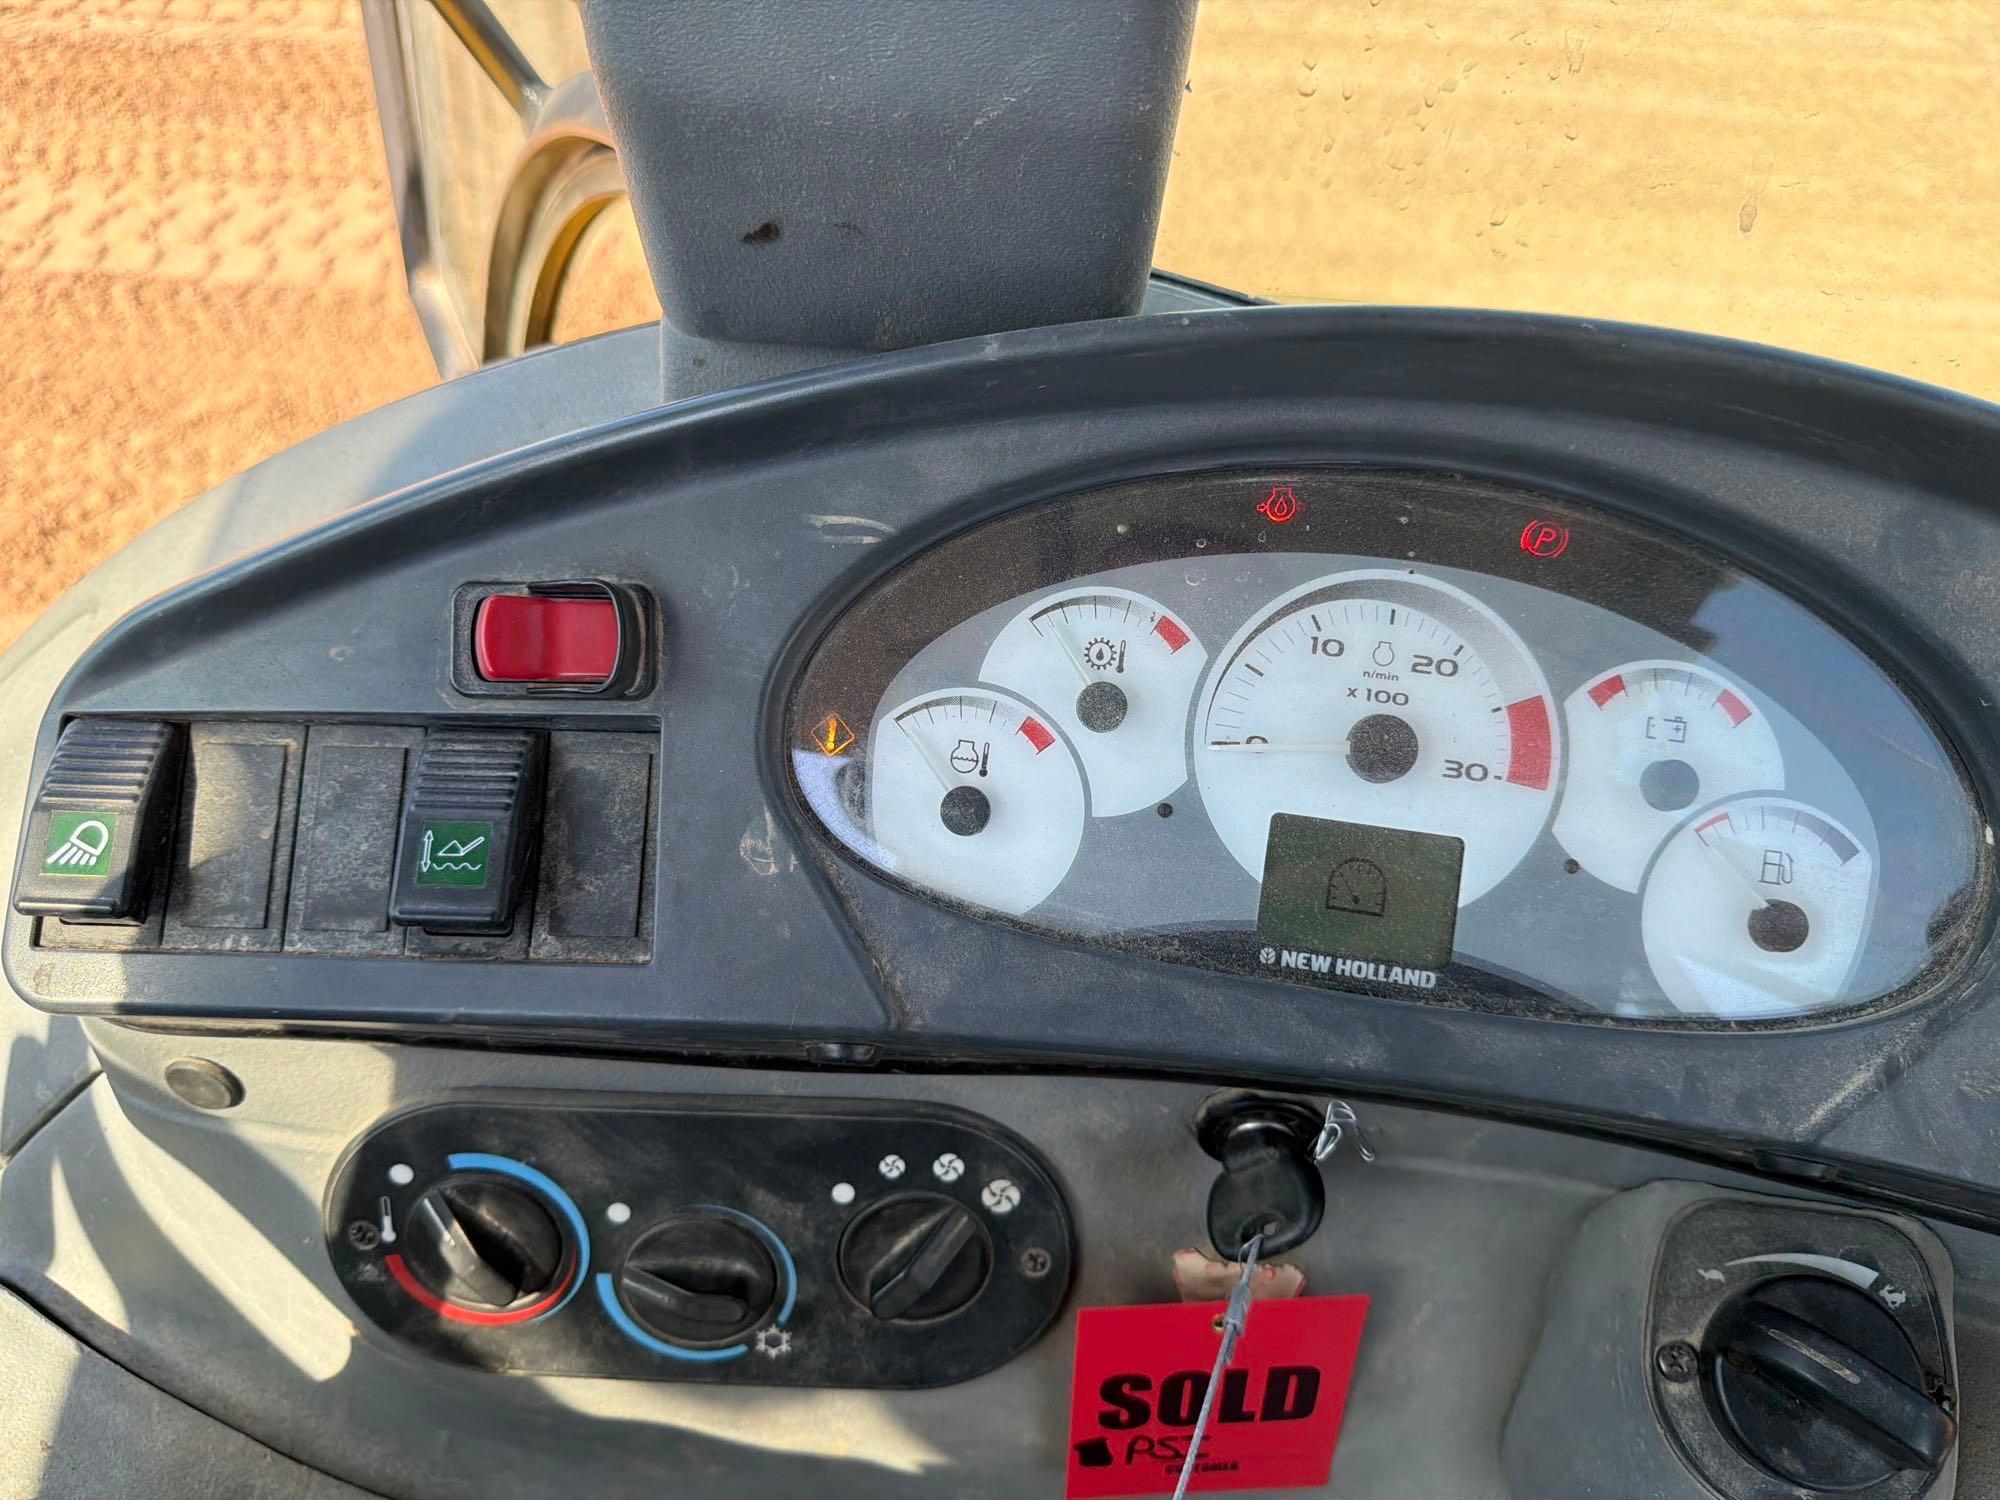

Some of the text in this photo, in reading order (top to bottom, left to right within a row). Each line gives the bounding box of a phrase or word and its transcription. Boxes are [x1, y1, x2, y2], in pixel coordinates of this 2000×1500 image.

[1310, 636, 1345, 658] 10
[1363, 669, 1400, 682] n/min
[1410, 654, 1459, 677] 20
[1366, 688, 1410, 706] 100
[1442, 759, 1489, 782] 30
[1281, 950, 1437, 989] NEW HOLLAND
[1098, 1365, 1321, 1431] SOLD
